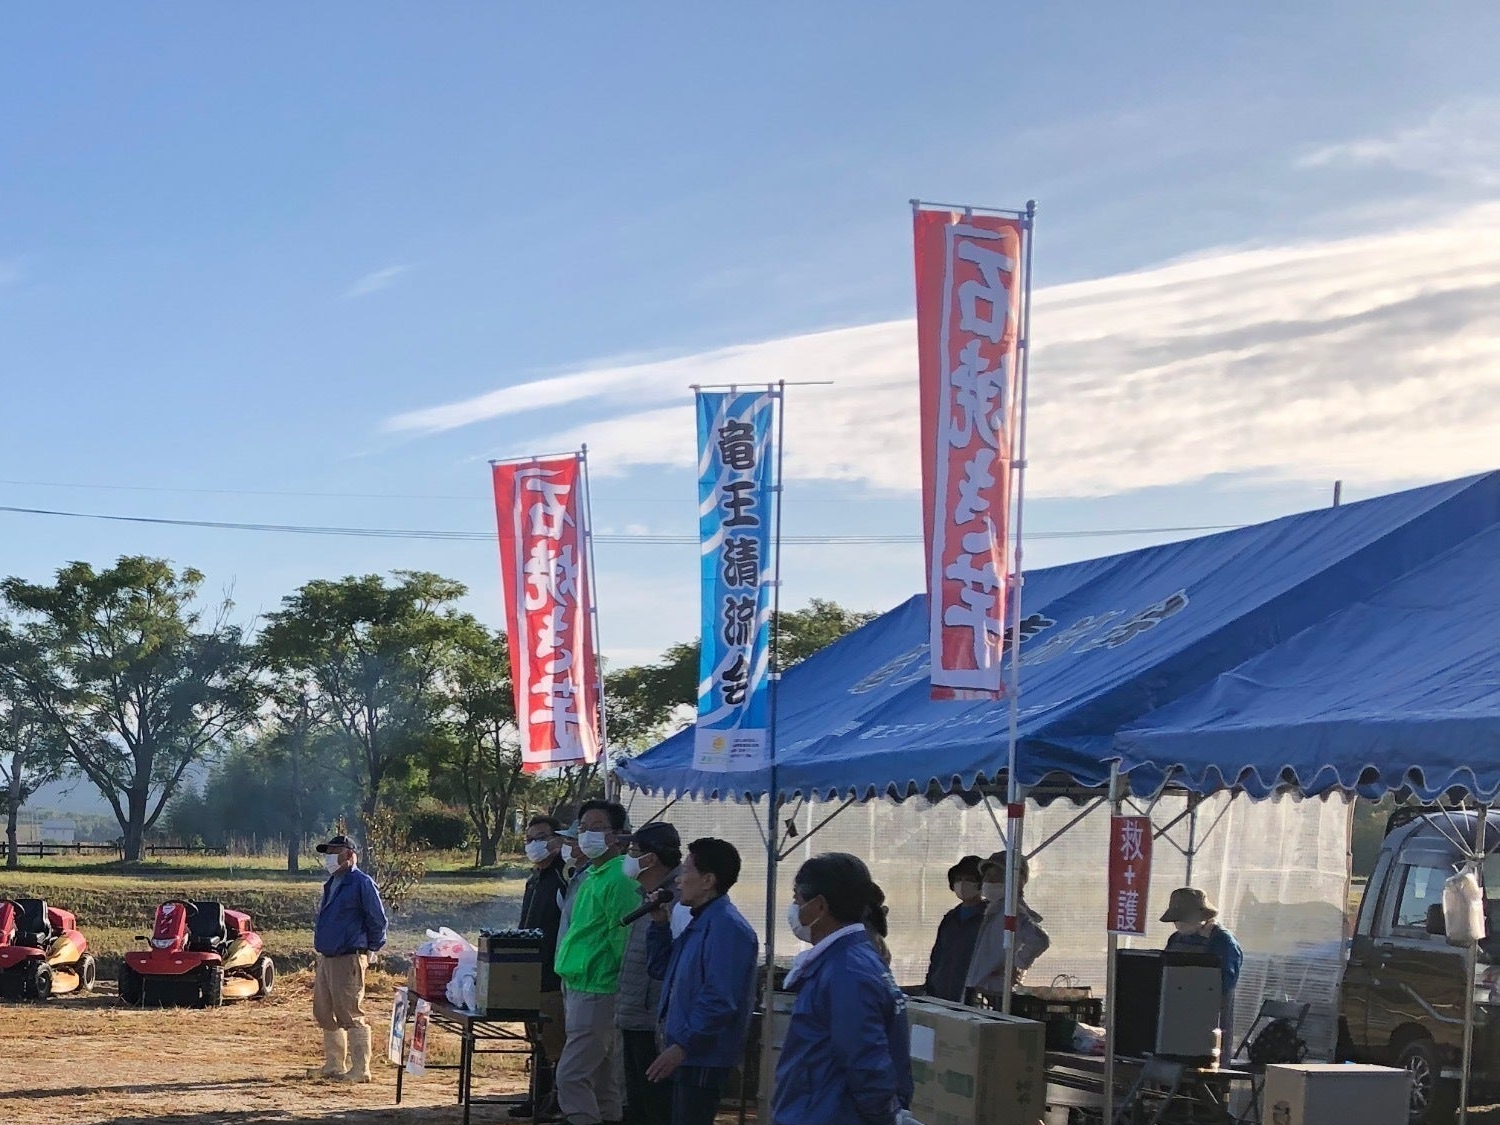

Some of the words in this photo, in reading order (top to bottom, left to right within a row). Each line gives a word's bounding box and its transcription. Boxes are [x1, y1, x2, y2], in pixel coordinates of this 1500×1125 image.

[718, 420, 759, 705] 竜王清流会
